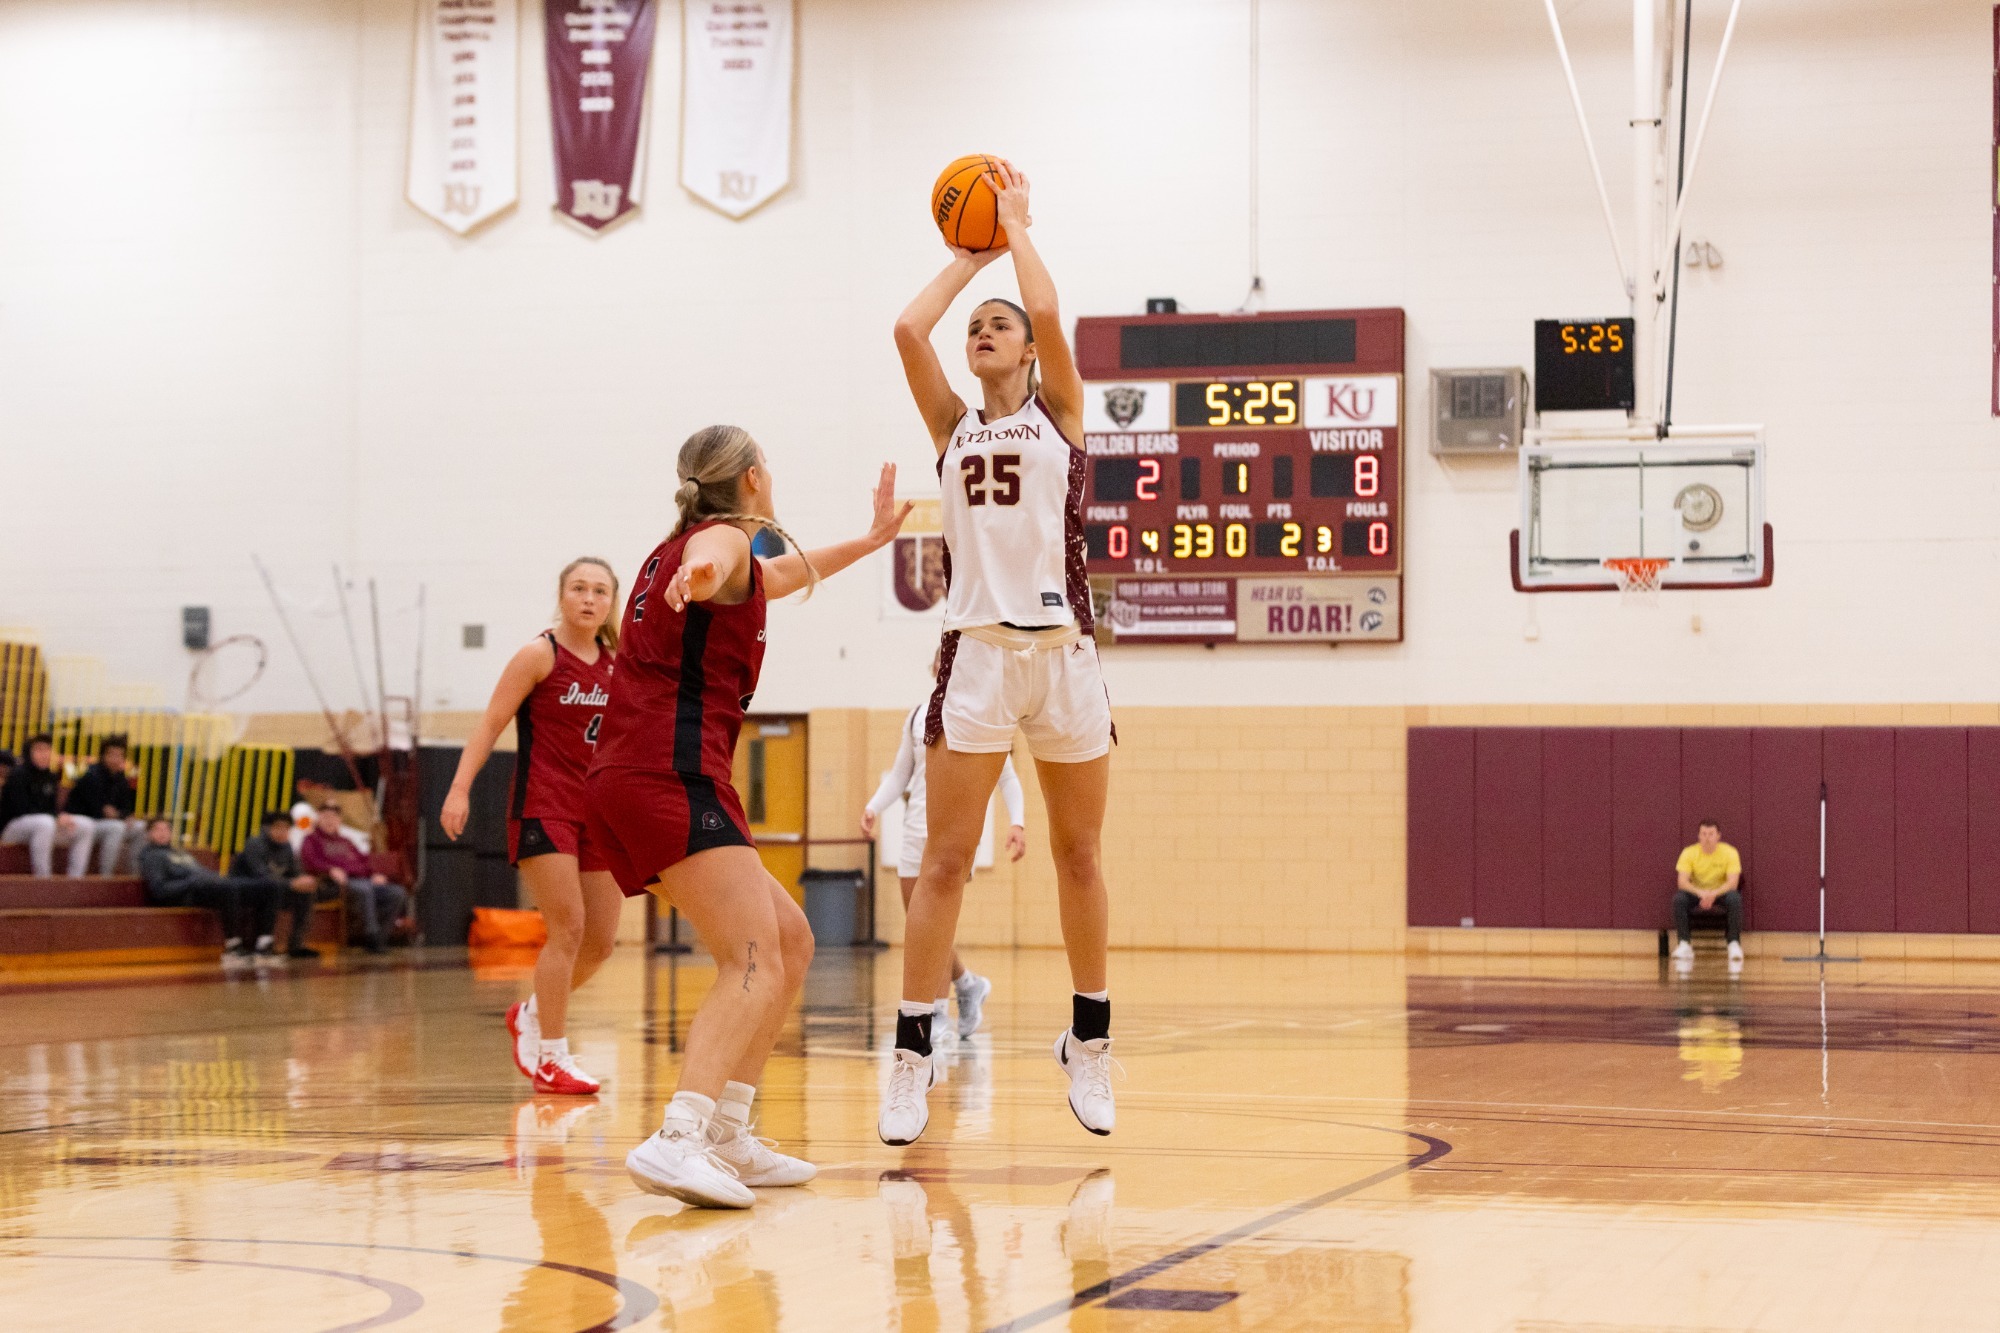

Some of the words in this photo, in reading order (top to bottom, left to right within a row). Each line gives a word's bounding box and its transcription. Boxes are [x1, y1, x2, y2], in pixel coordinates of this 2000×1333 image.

[1561, 324, 1624, 354] 5:25
[1206, 382, 1296, 426] 5:25
[1325, 383, 1376, 422] KU
[1085, 434, 1136, 456] GOLDEN
[1136, 433, 1179, 454] BEARS
[1213, 441, 1261, 458] PERIOD
[1309, 428, 1384, 452] VISITOR
[960, 454, 1021, 507] 25
[1136, 459, 1160, 500] 2
[1238, 463, 1247, 493] 1
[1354, 455, 1379, 496] 8
[1086, 505, 1128, 521] FOULS
[1176, 504, 1209, 520] PLYR
[1219, 503, 1252, 519] FOUL
[1267, 503, 1292, 519] PTS
[1346, 501, 1388, 517] FOULS
[1108, 525, 1128, 558] 0
[1141, 530, 1159, 553] 4
[1174, 524, 1214, 558] 33
[1226, 523, 1247, 558] 0
[1280, 522, 1301, 557] 2
[1317, 526, 1332, 553] 3
[1368, 522, 1388, 556] 0
[1306, 556, 1342, 571] T.O.L.
[1251, 586, 1284, 602] HEAR
[1286, 586, 1303, 601] US
[1196, 604, 1226, 615] STORE
[1268, 604, 1352, 633] ROAR!
[559, 682, 609, 706] India
